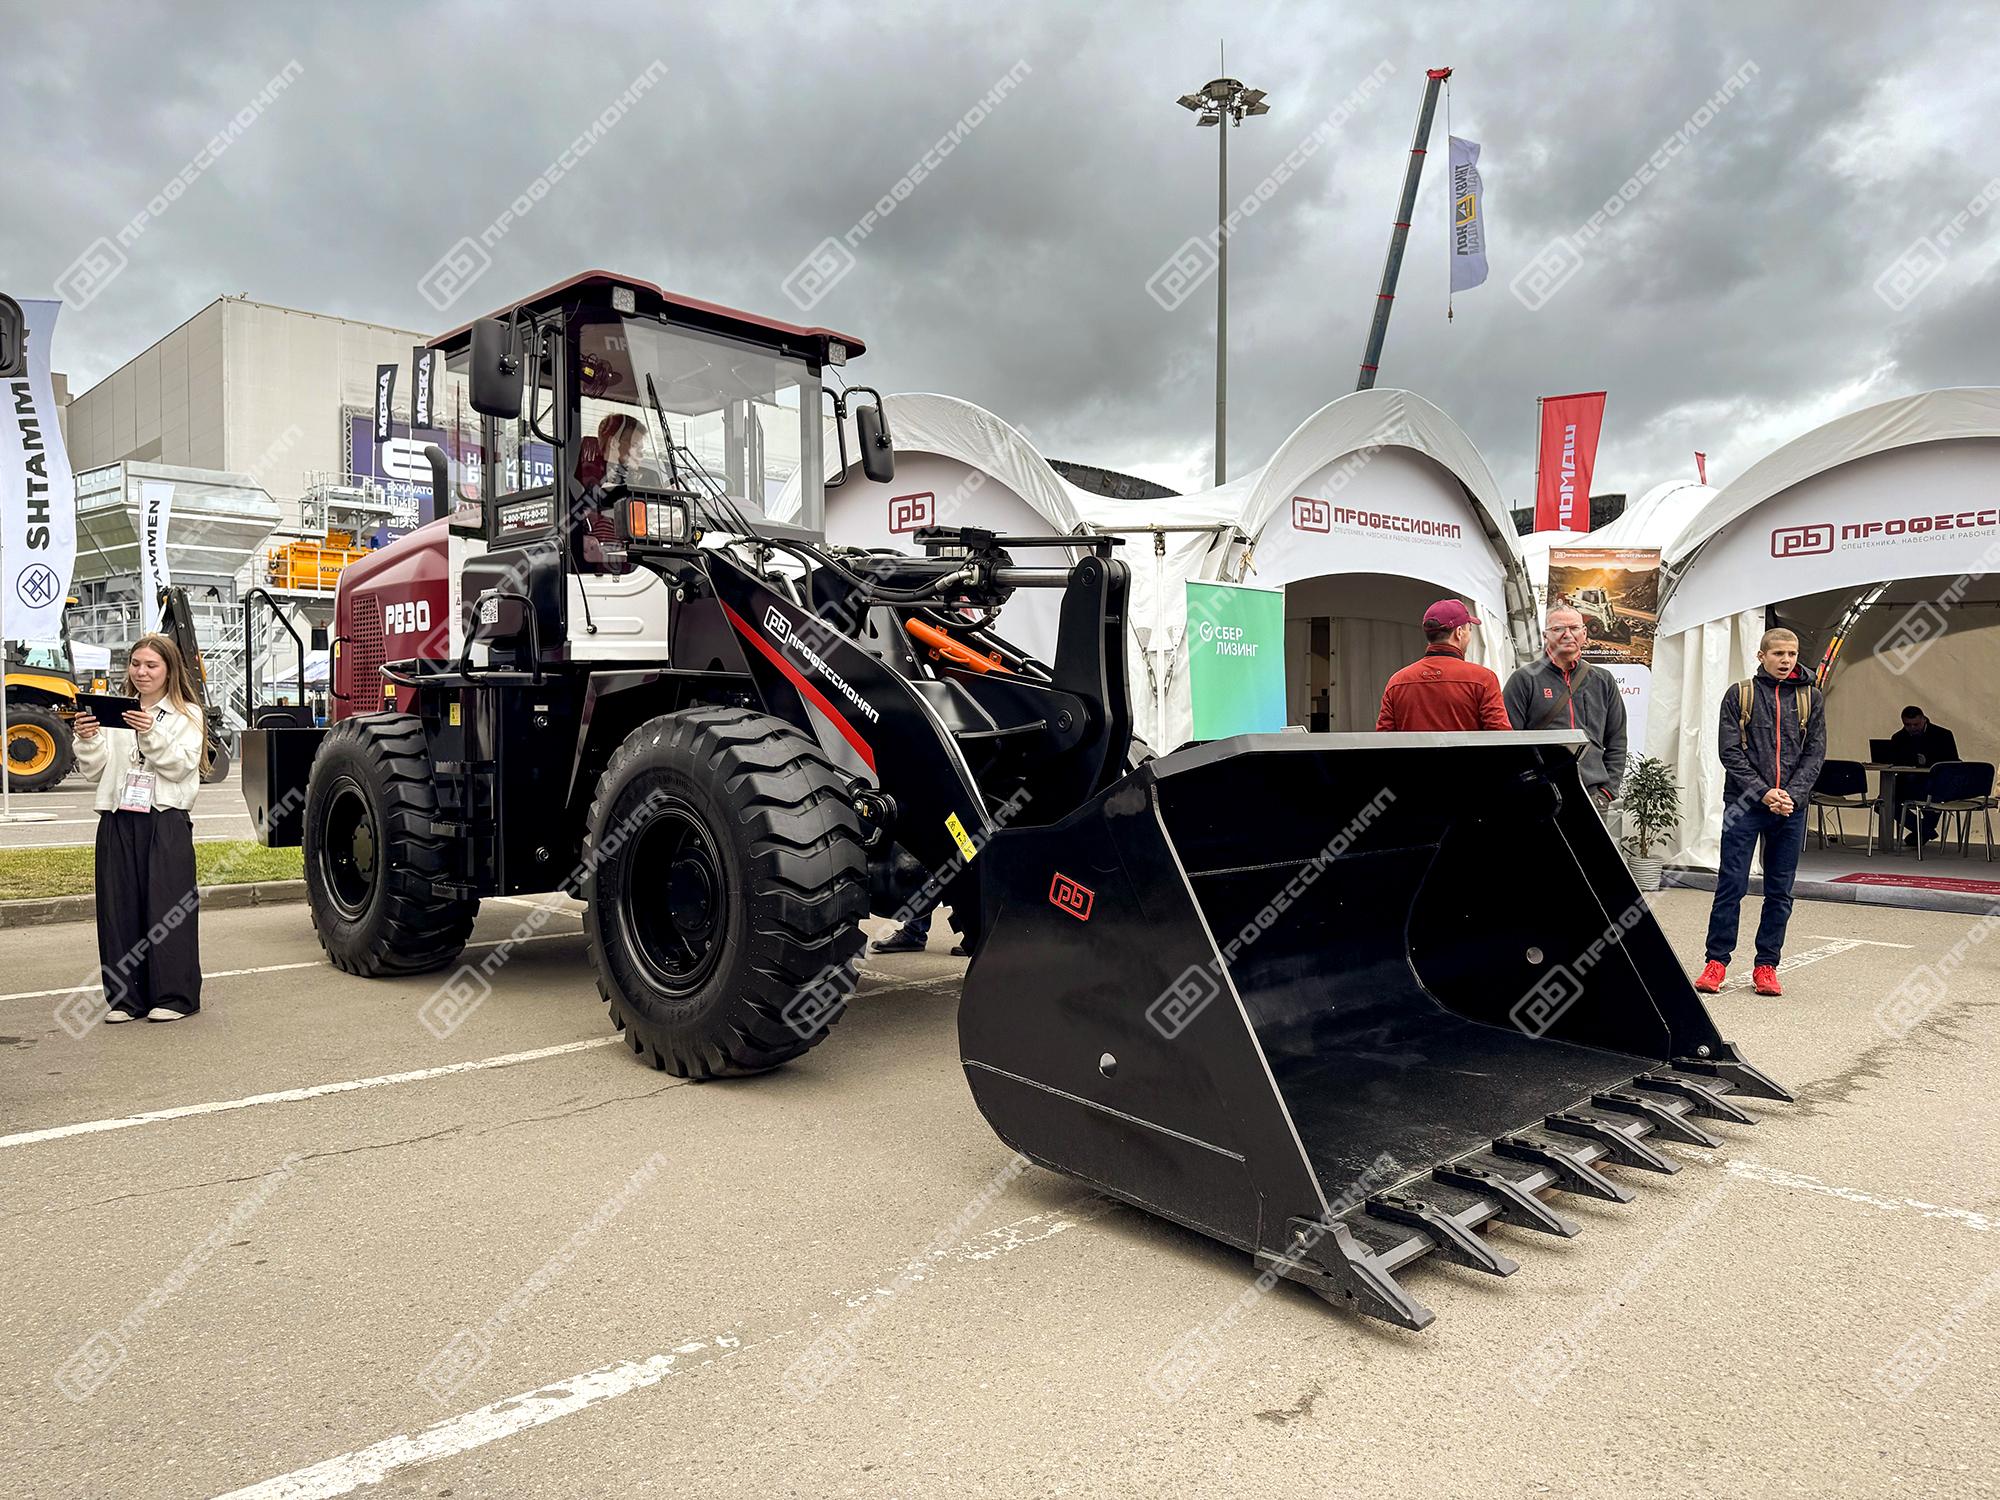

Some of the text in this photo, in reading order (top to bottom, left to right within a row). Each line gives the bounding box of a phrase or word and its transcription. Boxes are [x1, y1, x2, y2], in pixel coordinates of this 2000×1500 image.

[10, 329, 50, 551] SHTAMM
[1334, 507, 1461, 539] ПРОФЕССИОНАЛ
[1842, 508, 2000, 540] ПРОФЕСС
[1902, 534, 1946, 544] НАВЕСНОЕ
[1958, 529, 1996, 539] РАБОЧЕЕ
[385, 600, 430, 635] PB30
[1215, 627, 1243, 640] СБЕР
[1216, 642, 1258, 656] ЛИЗИНГ
[788, 632, 880, 724] ПРОФЕССИОНАЛ
